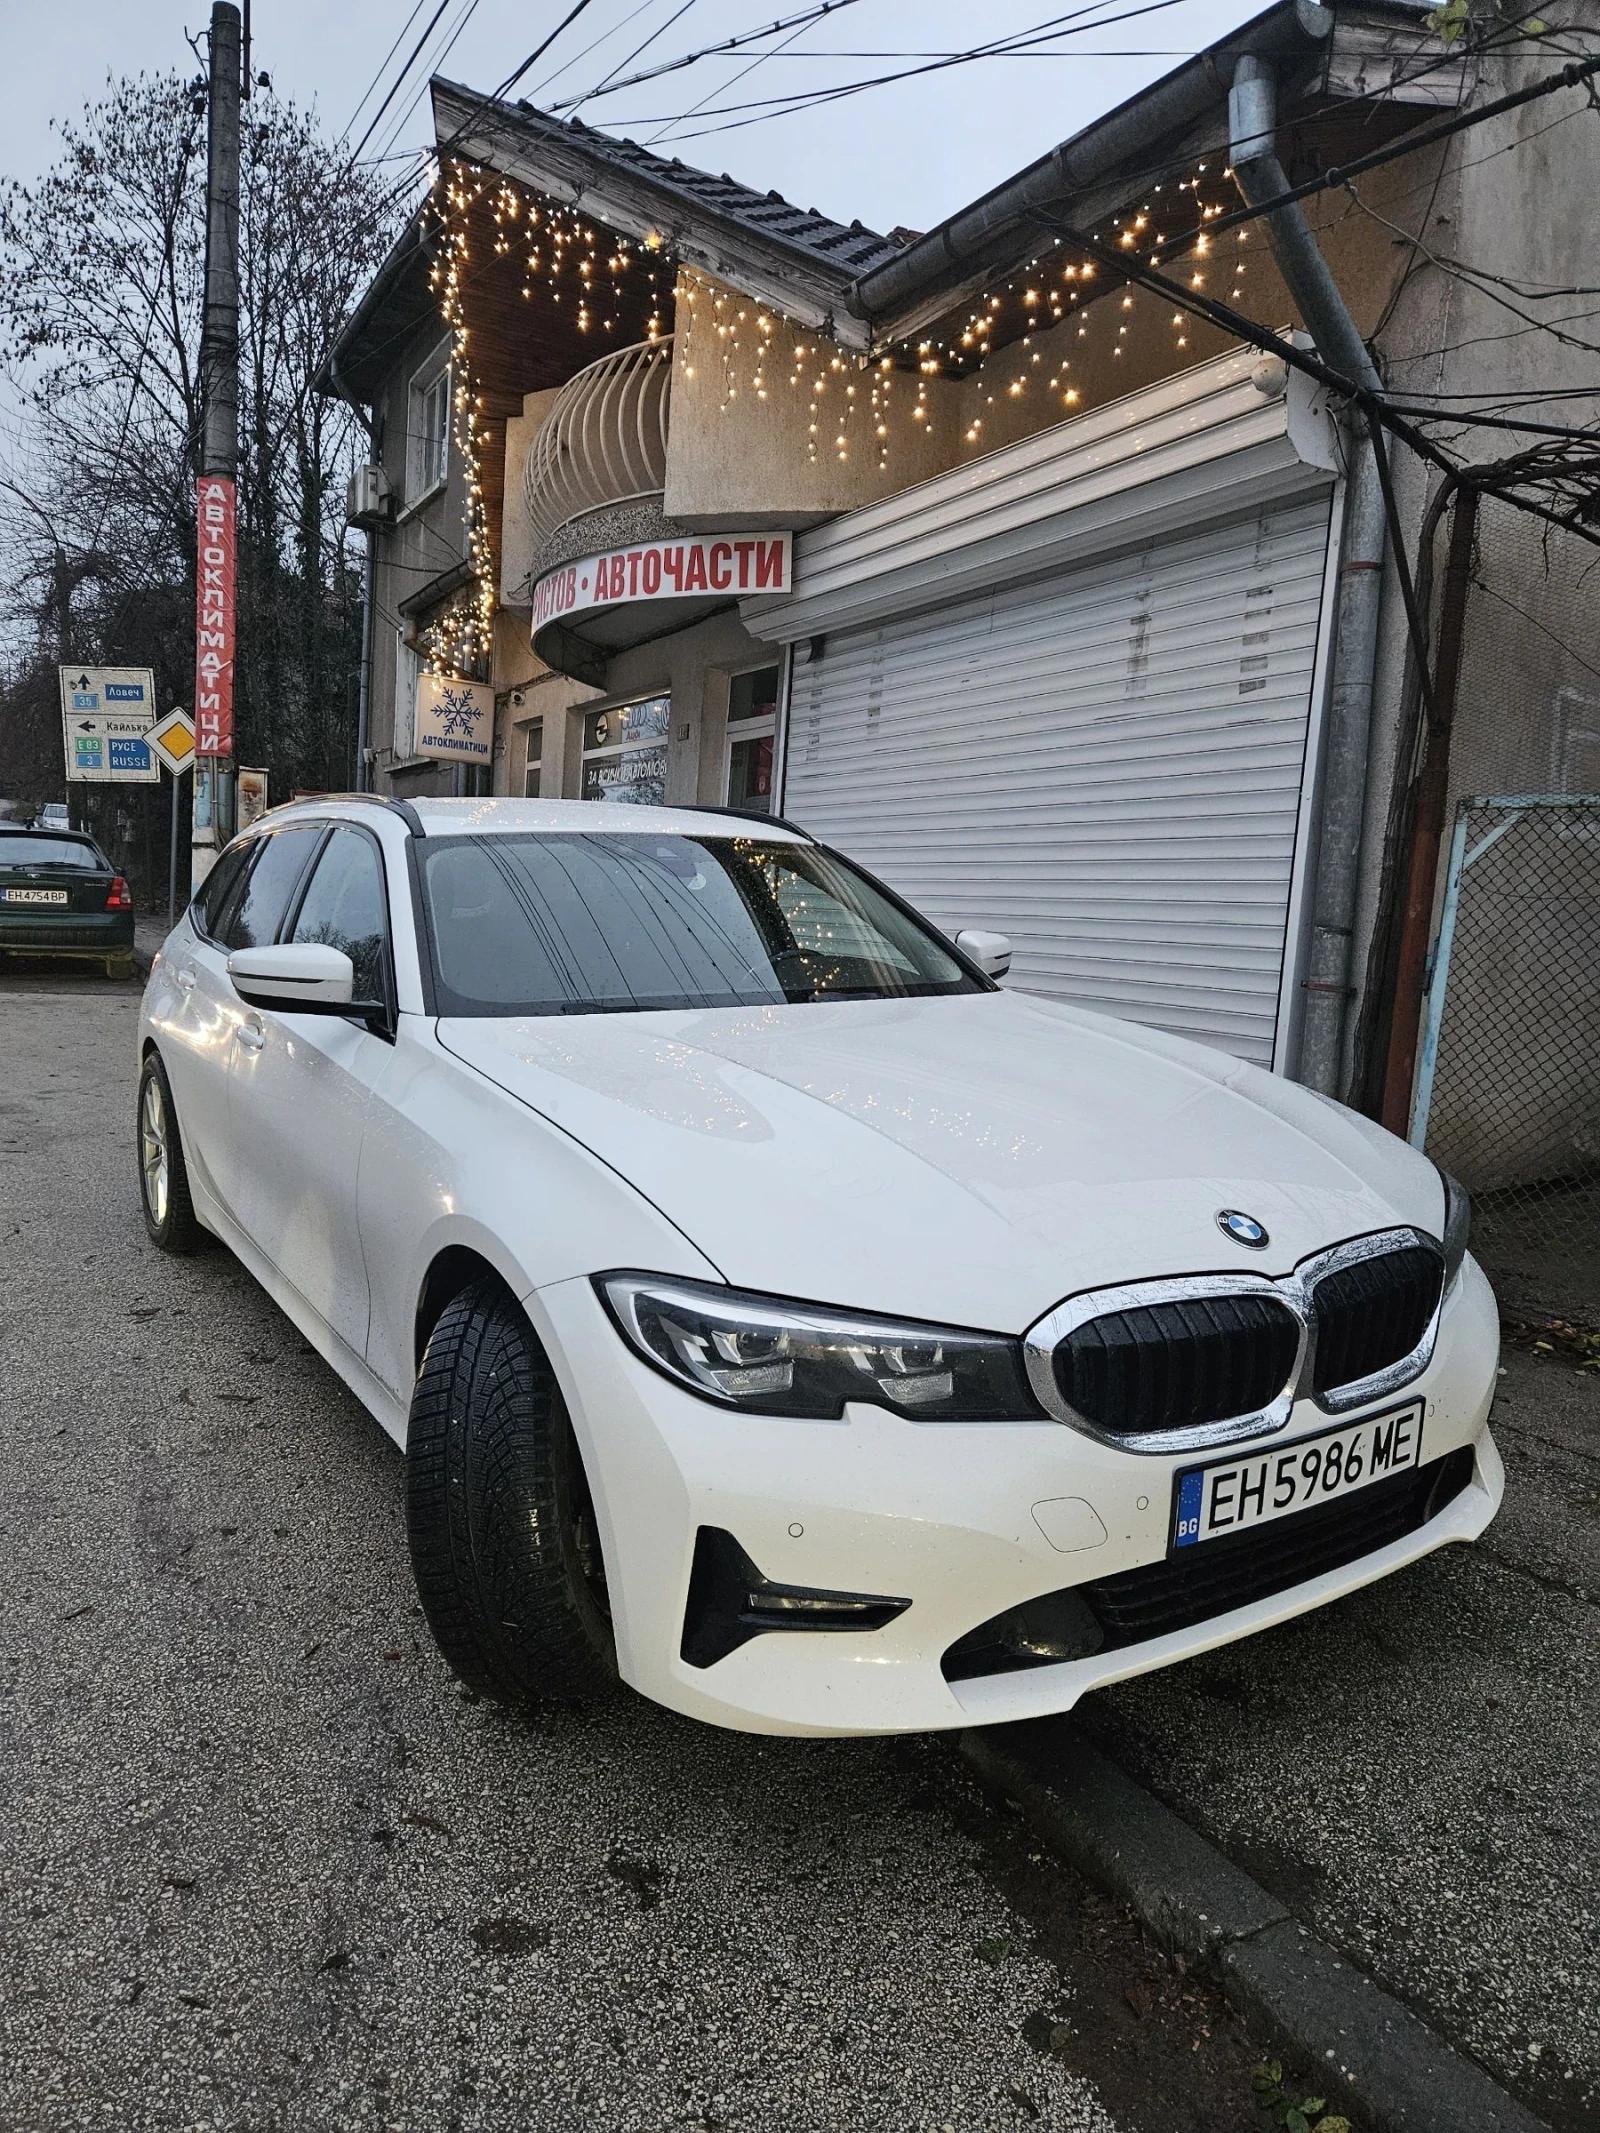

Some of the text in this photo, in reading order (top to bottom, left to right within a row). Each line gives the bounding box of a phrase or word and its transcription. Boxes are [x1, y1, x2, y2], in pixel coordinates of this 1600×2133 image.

[594, 540, 784, 602] АВТОЧАСТИ
[200, 484, 227, 751] АВТОКЛИМАТИЦИ
[109, 687, 139, 696] Ловеч
[80, 697, 92, 706] 35
[111, 742, 137, 751] РУСЕ
[422, 735, 488, 755] АВТОКЛИМАТИЦИ
[87, 756, 93, 766] 3
[112, 756, 147, 767] RUSSE
[588, 770, 597, 785] ЗА
[1178, 1518, 1198, 1537] BG
